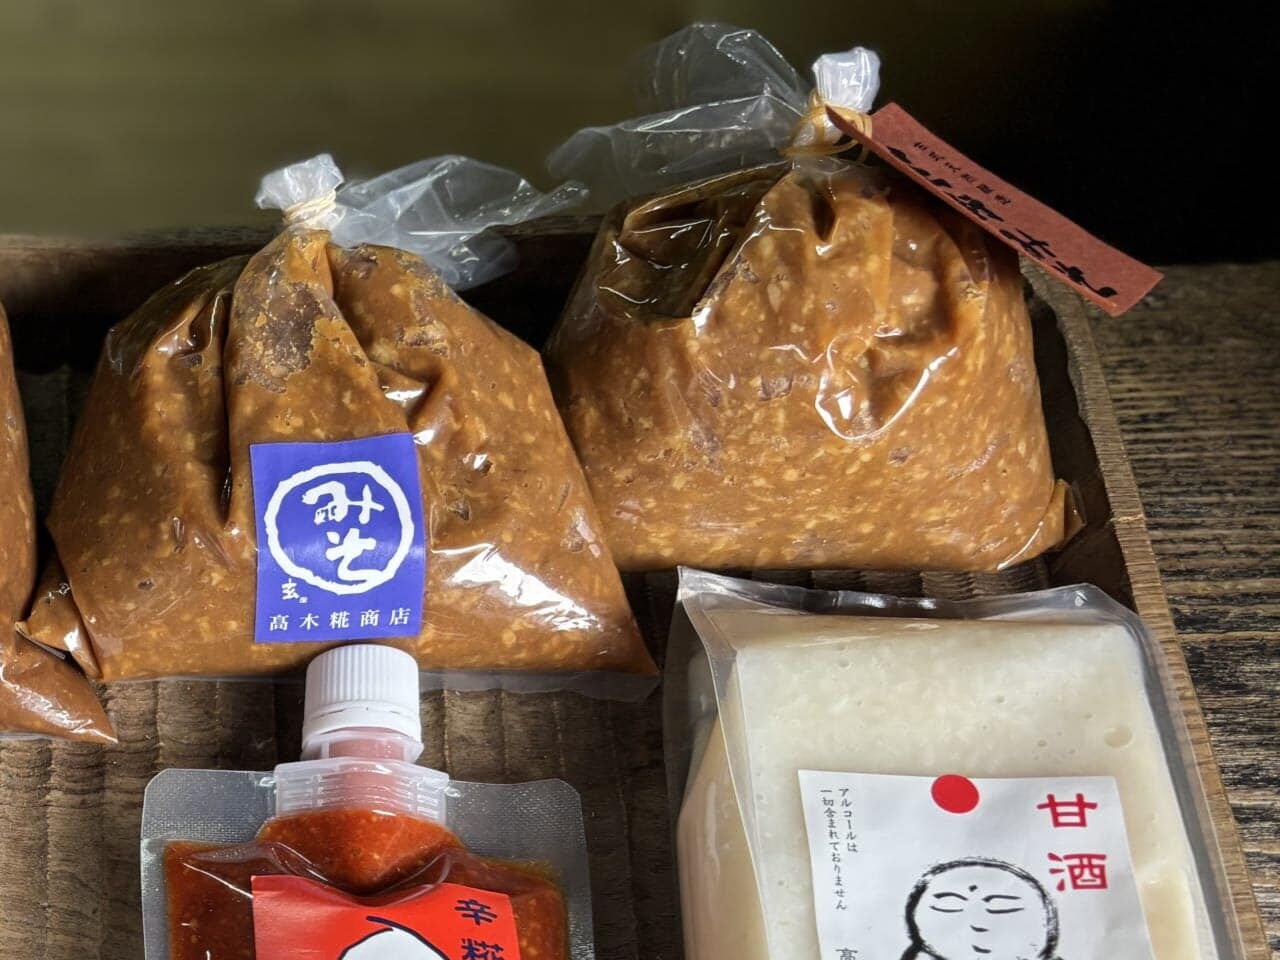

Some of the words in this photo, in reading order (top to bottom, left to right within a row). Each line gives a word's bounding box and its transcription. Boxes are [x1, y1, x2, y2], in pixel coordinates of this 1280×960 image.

[838, 787, 858, 853] アルコールは
[1037, 792, 1109, 892] 甘酒
